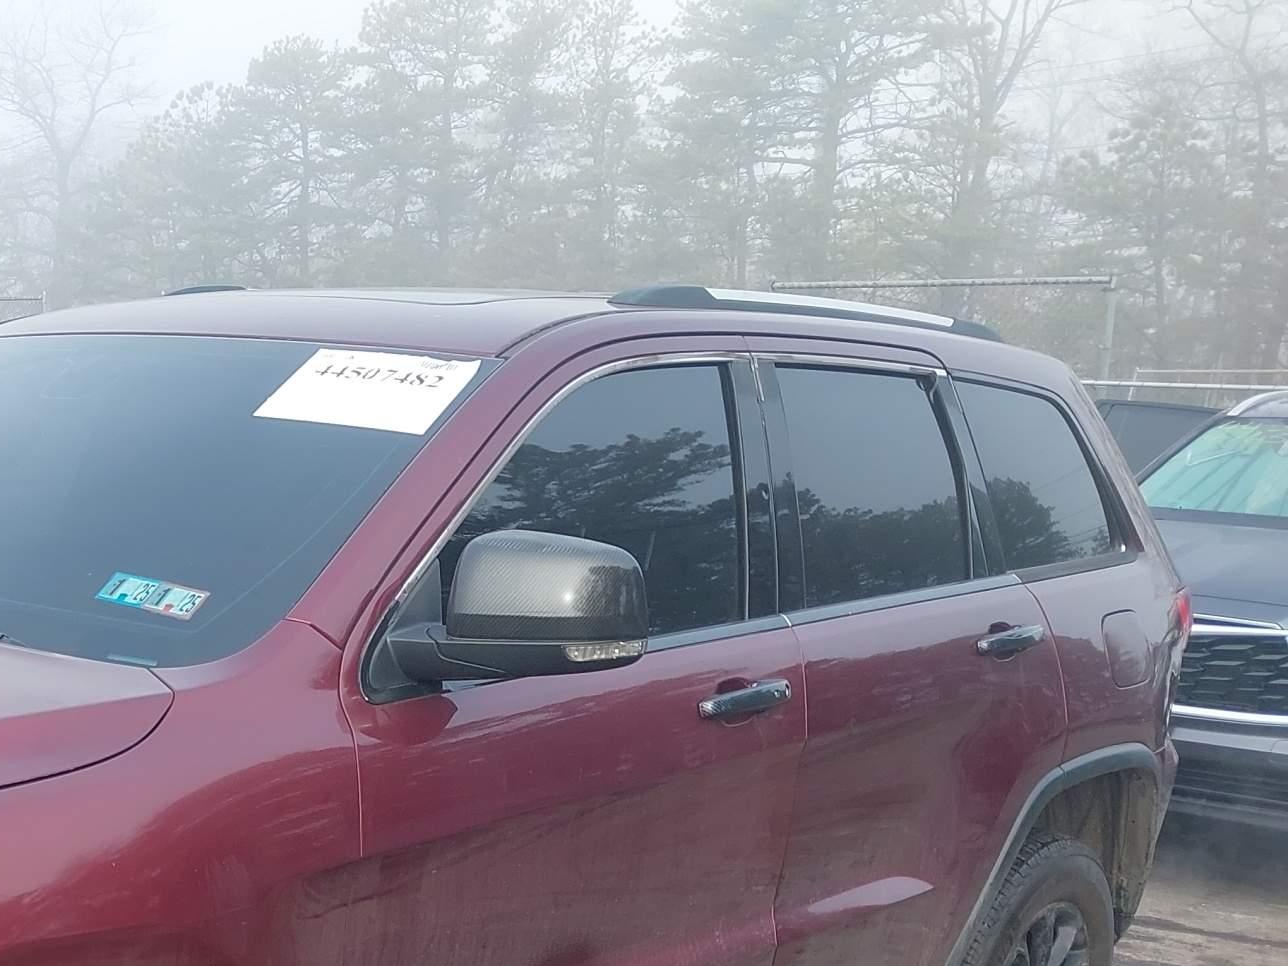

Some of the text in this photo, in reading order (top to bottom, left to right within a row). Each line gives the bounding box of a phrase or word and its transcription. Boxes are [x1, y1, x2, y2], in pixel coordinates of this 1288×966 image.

[315, 364, 446, 388] 44507482
[133, 583, 155, 602] 25
[179, 594, 203, 613] 25
